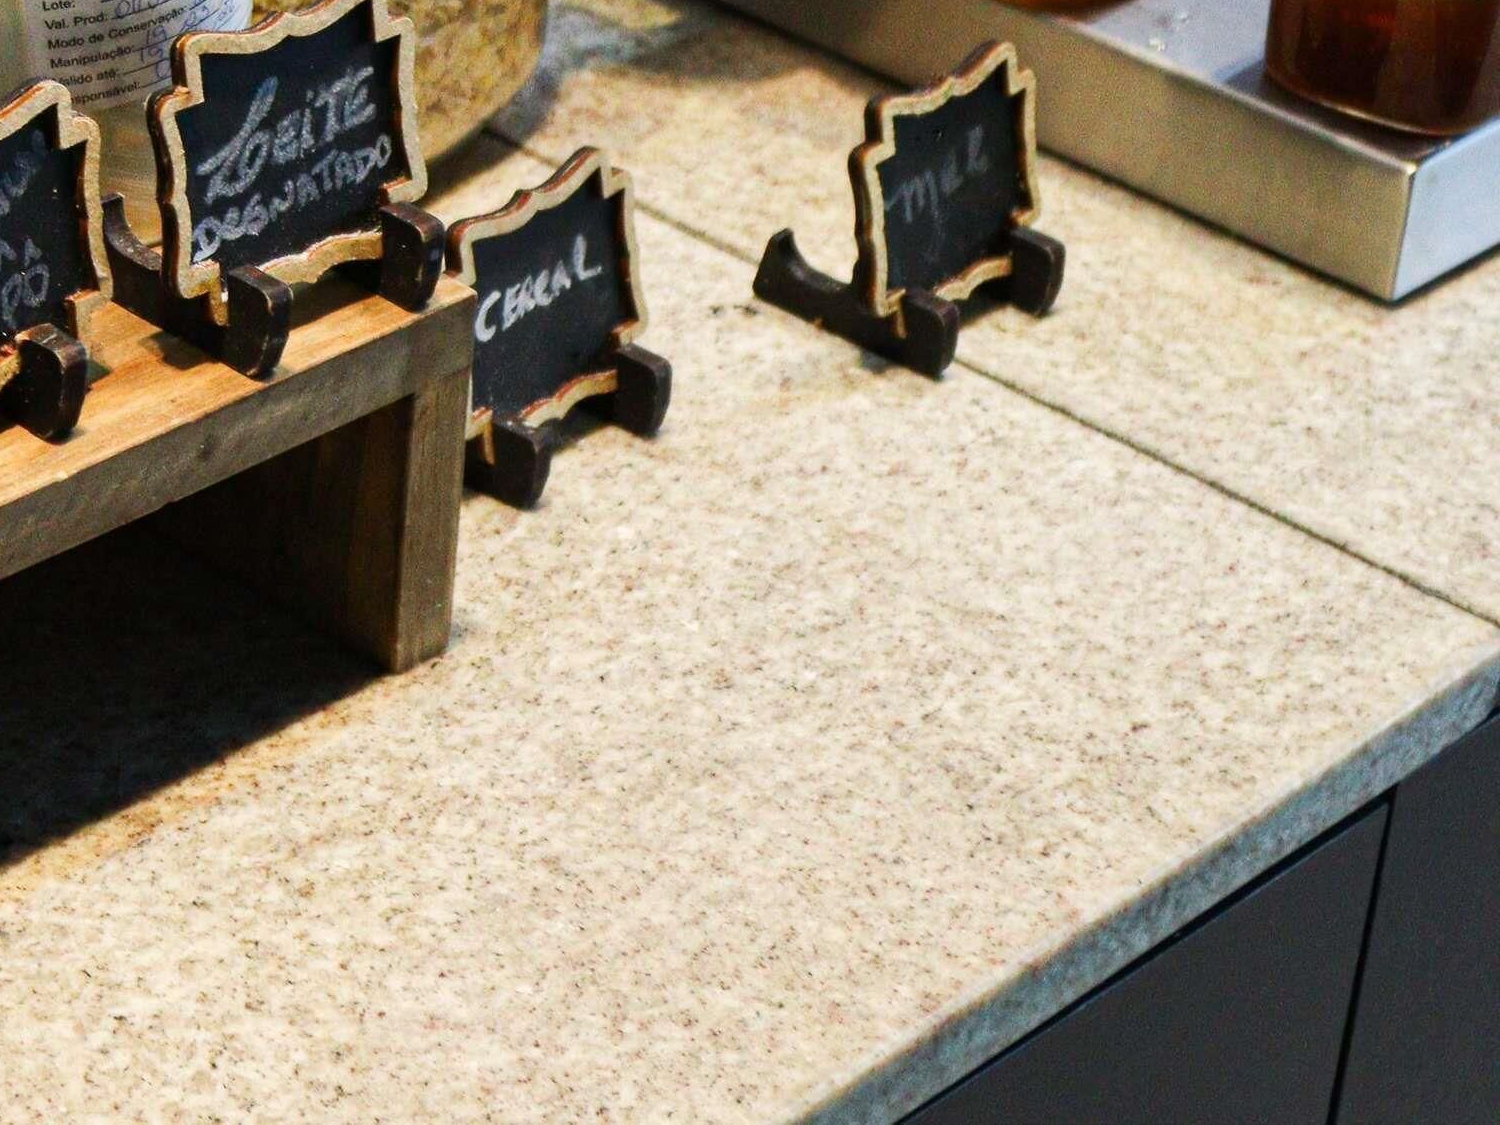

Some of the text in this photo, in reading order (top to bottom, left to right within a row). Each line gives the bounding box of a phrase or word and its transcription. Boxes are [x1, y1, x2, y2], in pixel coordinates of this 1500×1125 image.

[42, 0, 76, 13] Lote:
[48, 4, 190, 51] Modo de Conservação:
[74, 12, 109, 27] Prod:
[51, 44, 135, 69] Manipulação:
